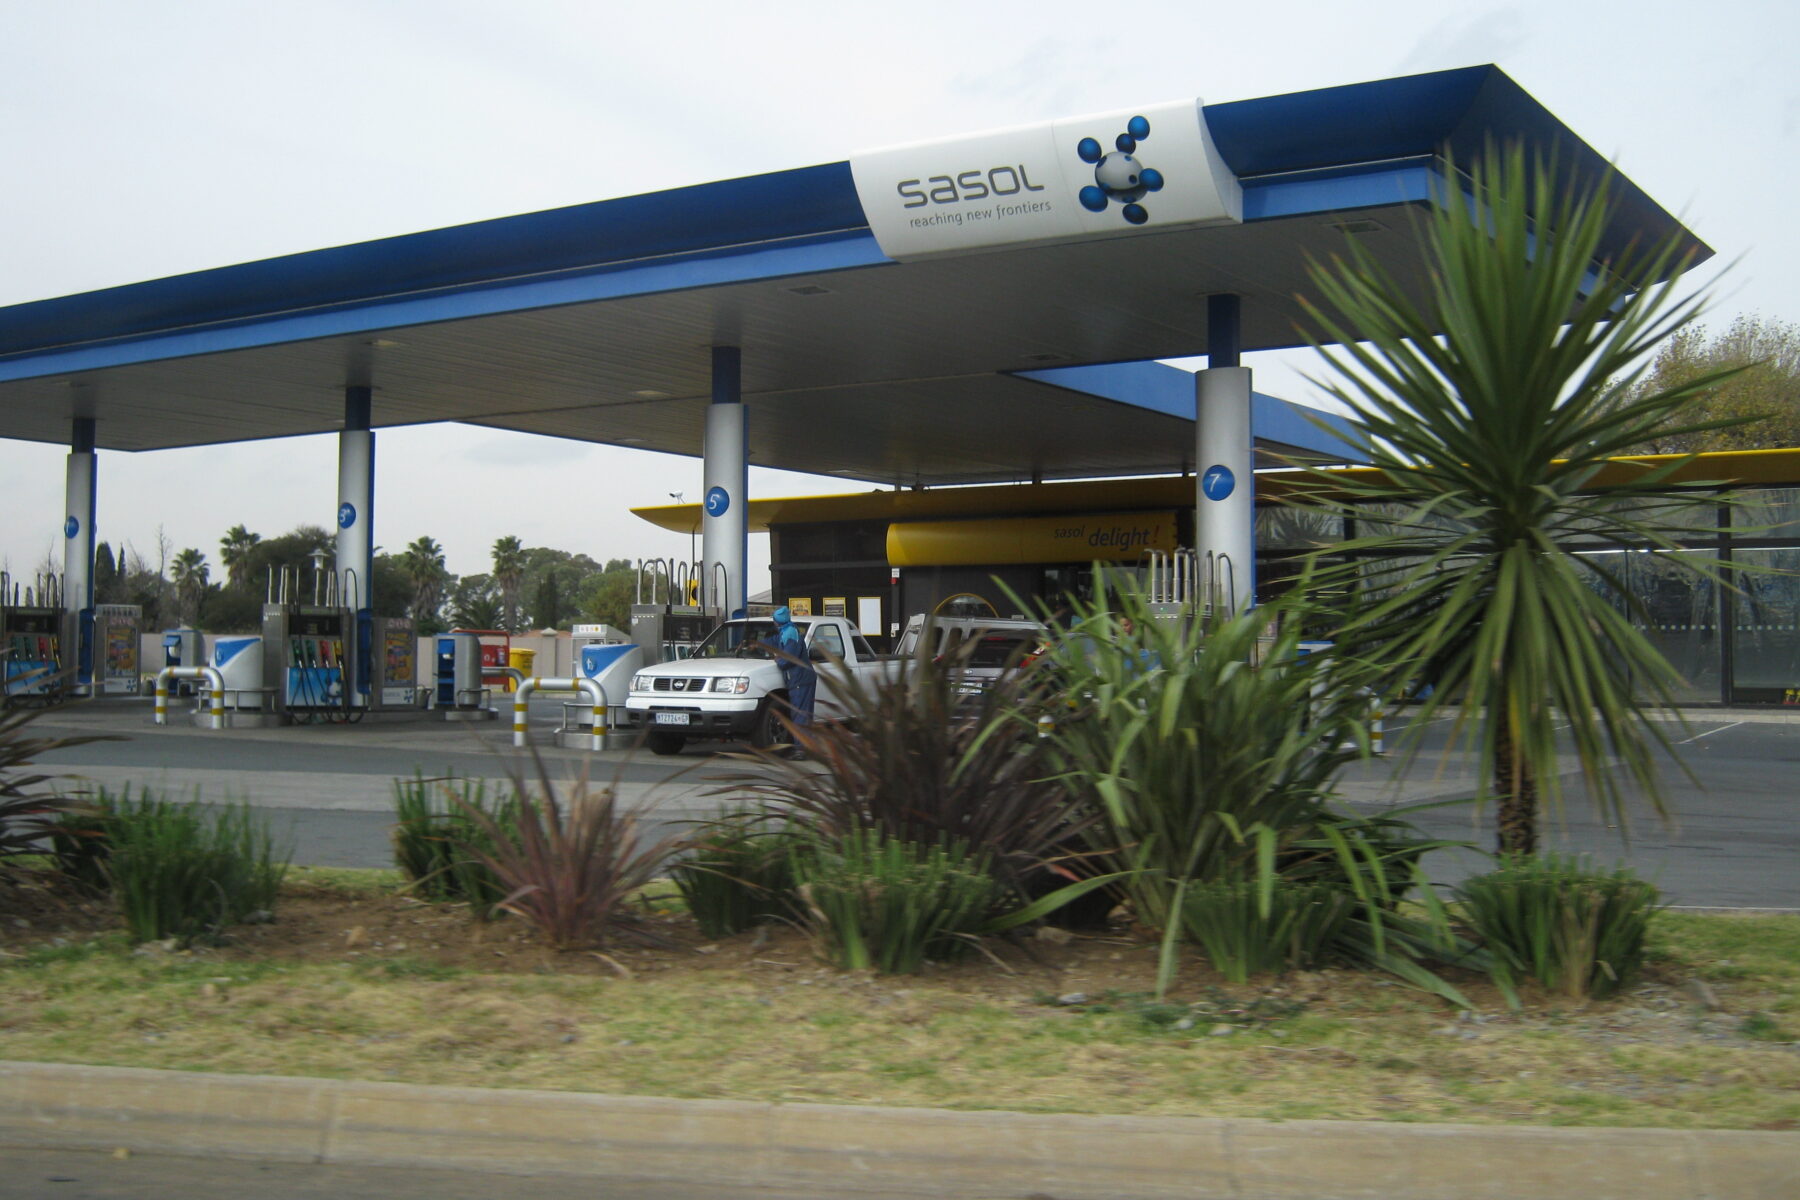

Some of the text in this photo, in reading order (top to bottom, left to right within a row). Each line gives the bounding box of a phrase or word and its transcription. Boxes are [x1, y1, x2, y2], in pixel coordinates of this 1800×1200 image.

[909, 200, 1052, 228] reaching new frontiers
[1209, 473, 1222, 492] 7
[708, 493, 720, 510] 5
[1054, 525, 1086, 538] sasol
